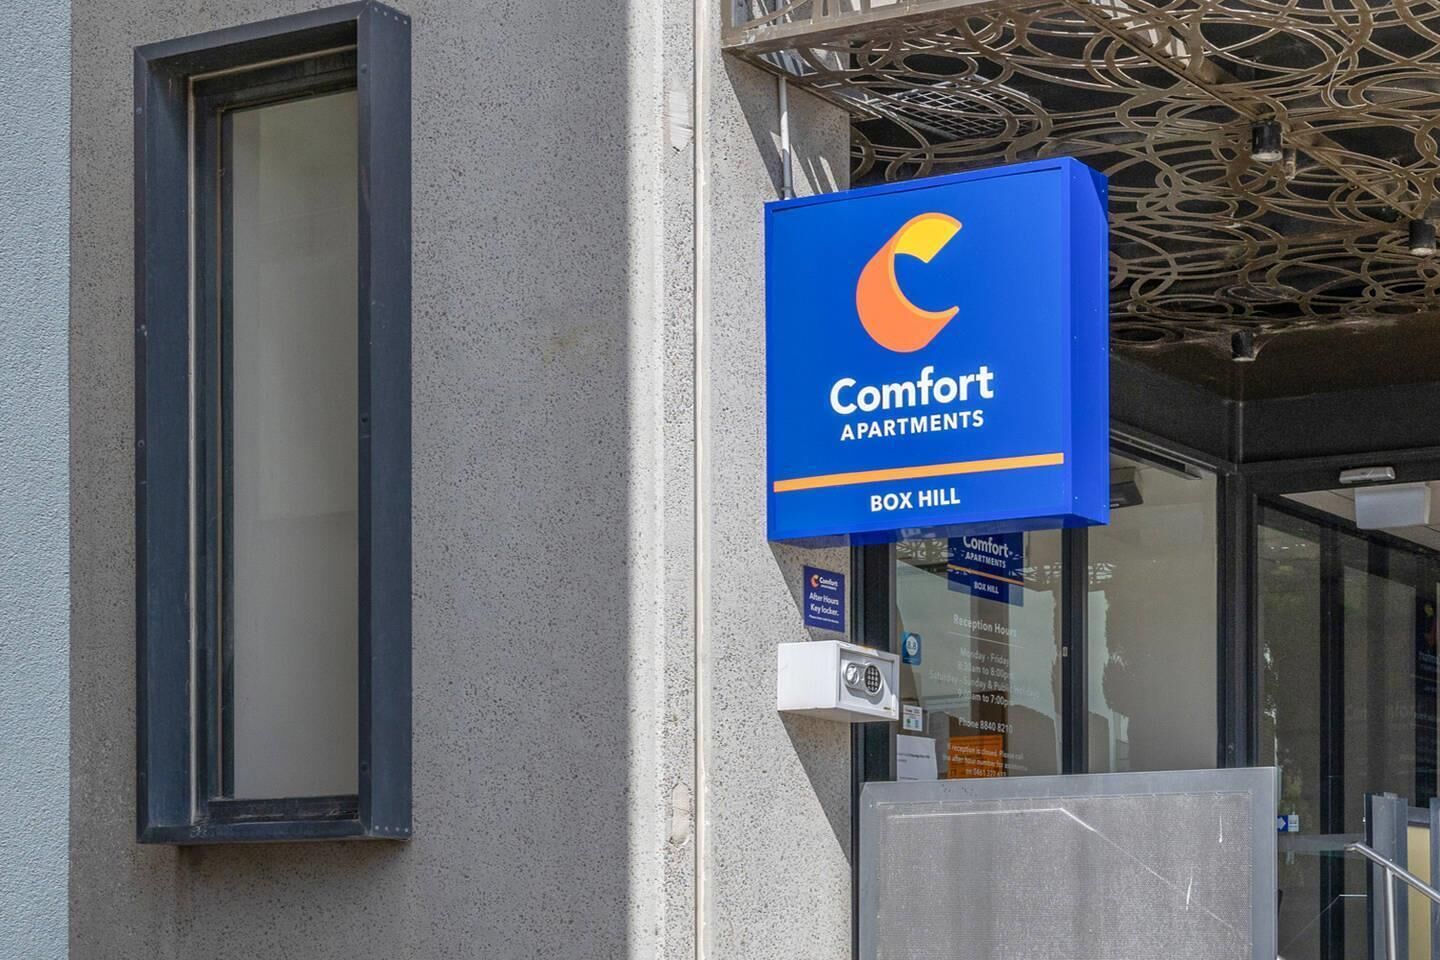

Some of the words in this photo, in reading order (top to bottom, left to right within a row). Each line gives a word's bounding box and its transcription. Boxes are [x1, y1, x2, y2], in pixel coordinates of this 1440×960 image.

[830, 366, 995, 415] Comfort
[840, 410, 985, 442] APARTMENTS
[870, 492, 913, 513] BOX
[918, 487, 961, 508] HILL
[963, 536, 1009, 558] Comfort
[964, 552, 1006, 569] APARTMENTS
[819, 576, 839, 588] Comfort
[974, 581, 987, 592] BOX
[987, 584, 999, 594] HILL
[809, 592, 823, 602] After
[823, 594, 839, 605] Hours
[810, 603, 821, 614] Key
[953, 613, 993, 632] Reception
[982, 694, 990, 703] to
[958, 716, 978, 729] Phone
[980, 720, 997, 731] 8840
